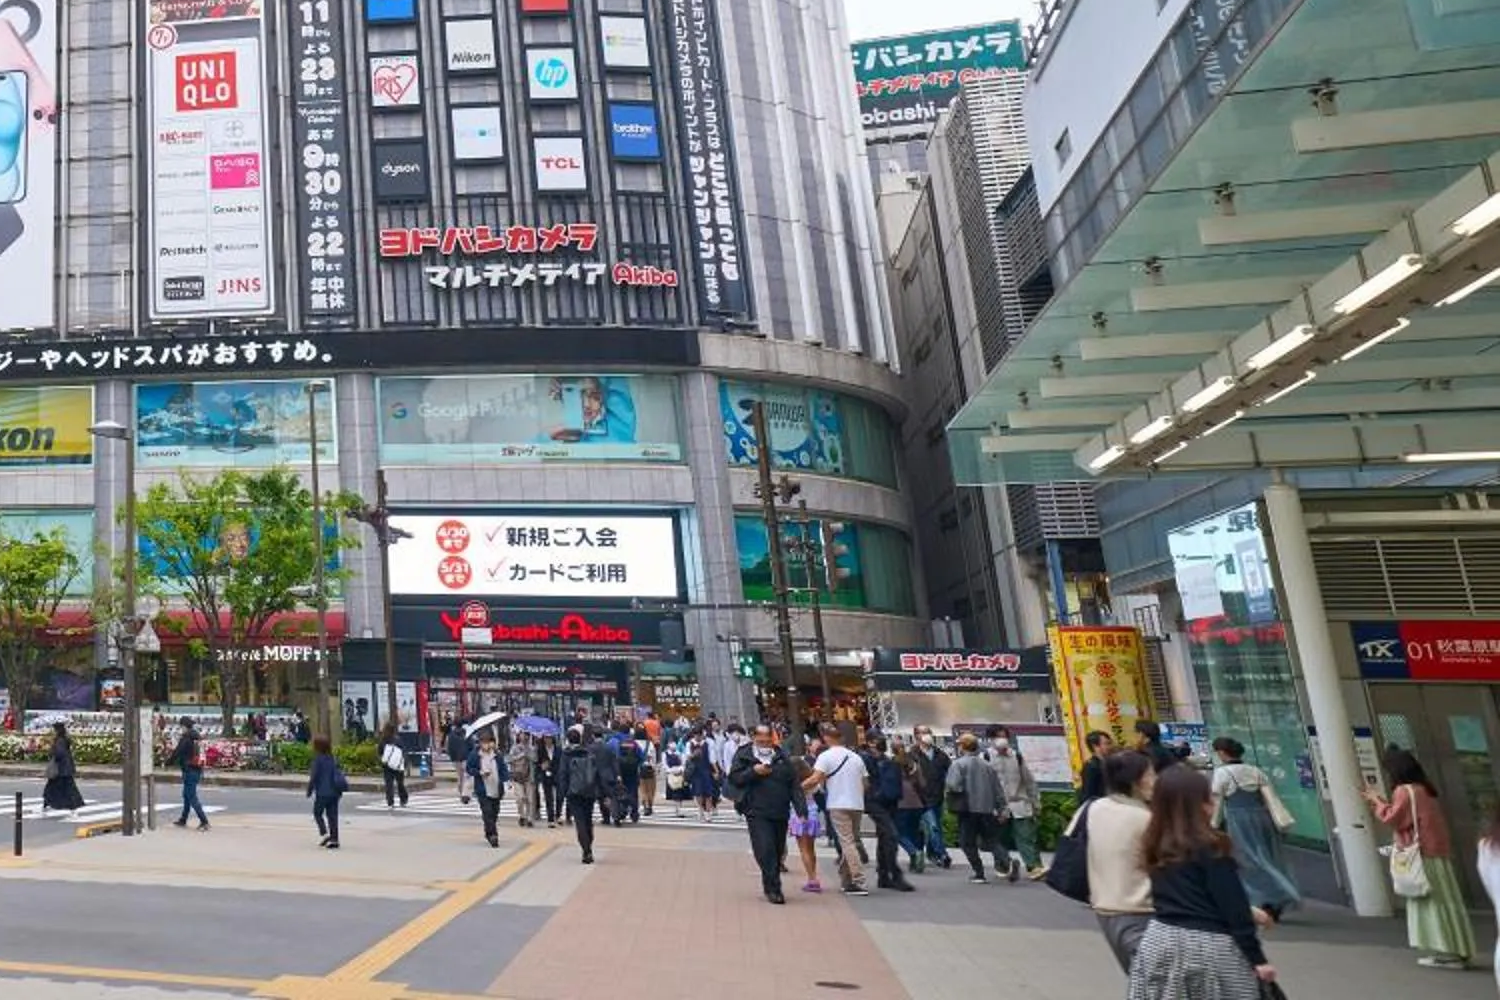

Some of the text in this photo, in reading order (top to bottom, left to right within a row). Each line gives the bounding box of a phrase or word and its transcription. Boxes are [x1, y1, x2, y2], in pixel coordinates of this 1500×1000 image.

[299, 0, 329, 23] 11
[304, 42, 331, 55] よる
[452, 53, 491, 65] Nikon
[182, 60, 226, 81] UNI
[301, 57, 336, 81] 23
[183, 82, 231, 106] QLO
[307, 128, 334, 141] あさ
[381, 161, 421, 177] dyson
[541, 157, 581, 170] TCL
[305, 170, 342, 195] 30
[311, 216, 339, 228] よる
[307, 231, 345, 257] 22
[378, 221, 599, 257] ヨドバシカメラ
[425, 262, 679, 290] マルチメディア Akiba
[437, 527, 468, 538] 4/30
[506, 526, 618, 548] 新規ご入会
[444, 538, 463, 549] まで
[441, 561, 470, 573] 5/31
[509, 563, 628, 583] カードご利用
[445, 573, 465, 584] まで
[1359, 639, 1400, 658] TX
[1406, 641, 1434, 661] 01
[901, 653, 1021, 672] ヨドバシカメラ
